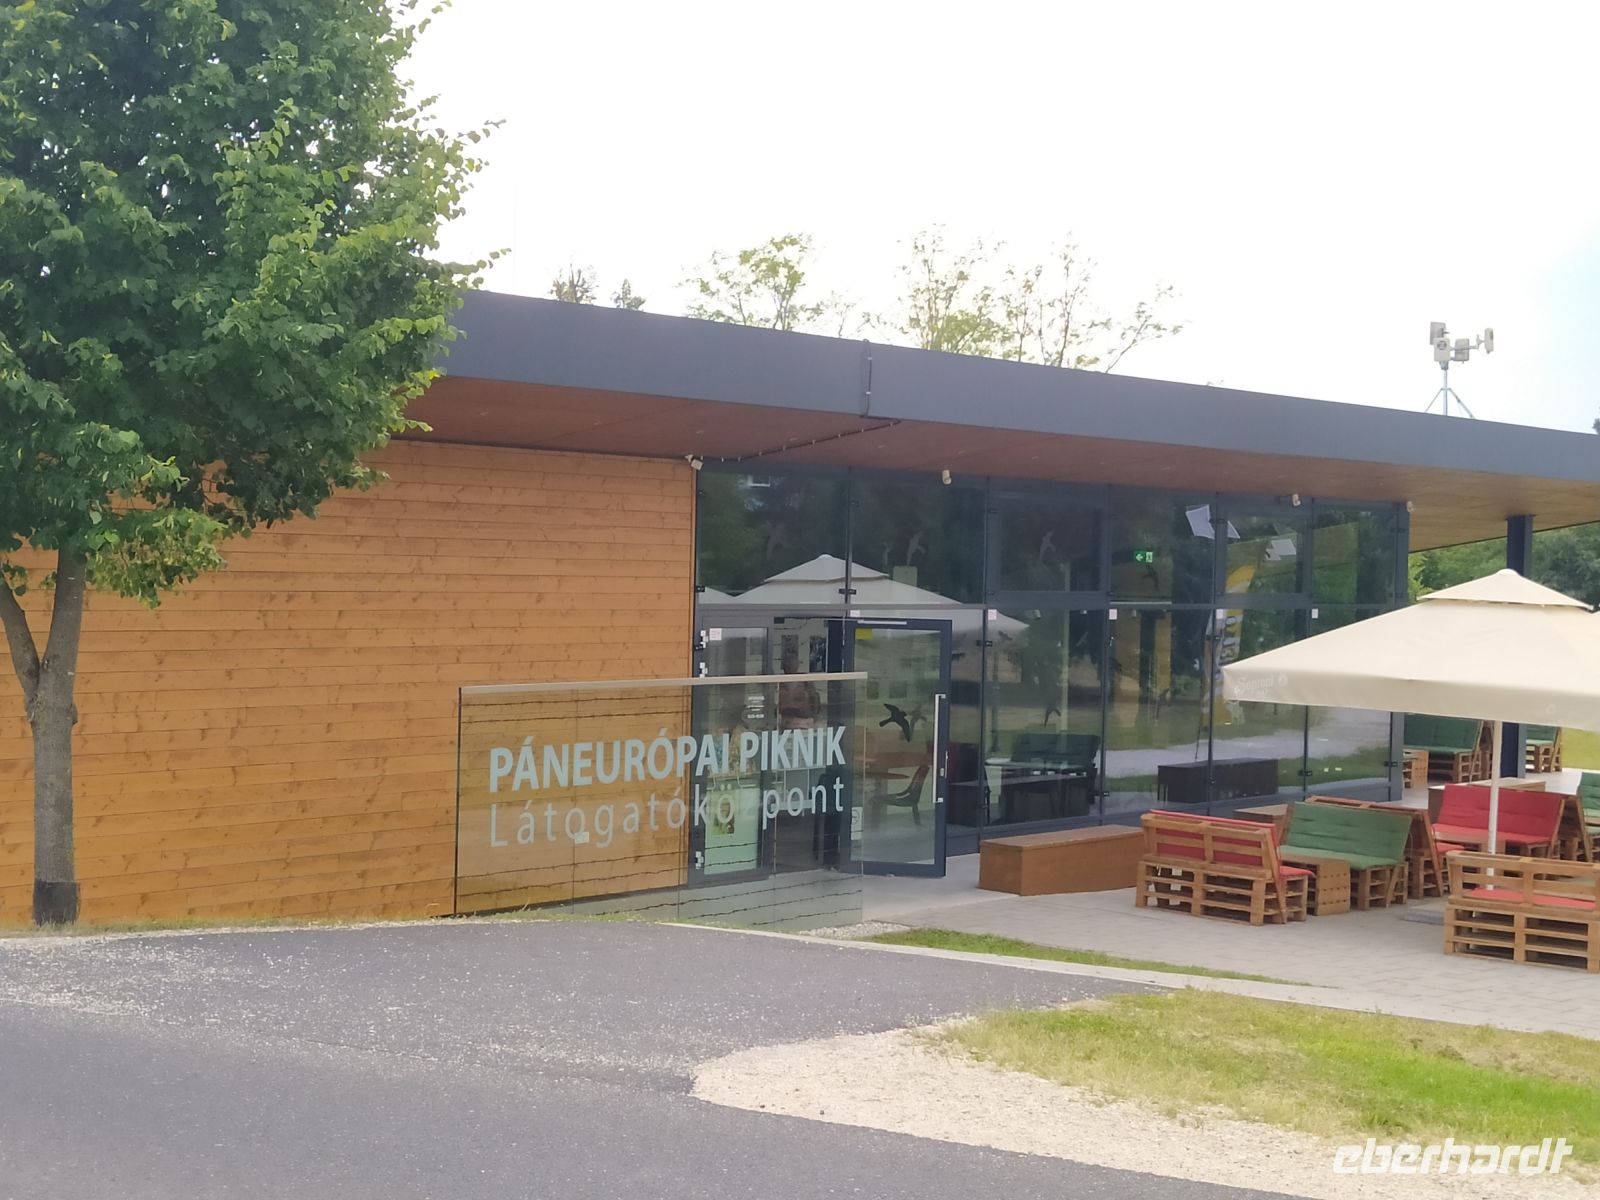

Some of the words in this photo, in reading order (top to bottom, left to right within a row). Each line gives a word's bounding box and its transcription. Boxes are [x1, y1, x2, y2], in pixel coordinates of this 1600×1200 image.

[489, 726, 729, 793] PÁNEURÓPAI
[740, 726, 847, 773] PIKNIK
[490, 776, 844, 848] Látogatóköpont
